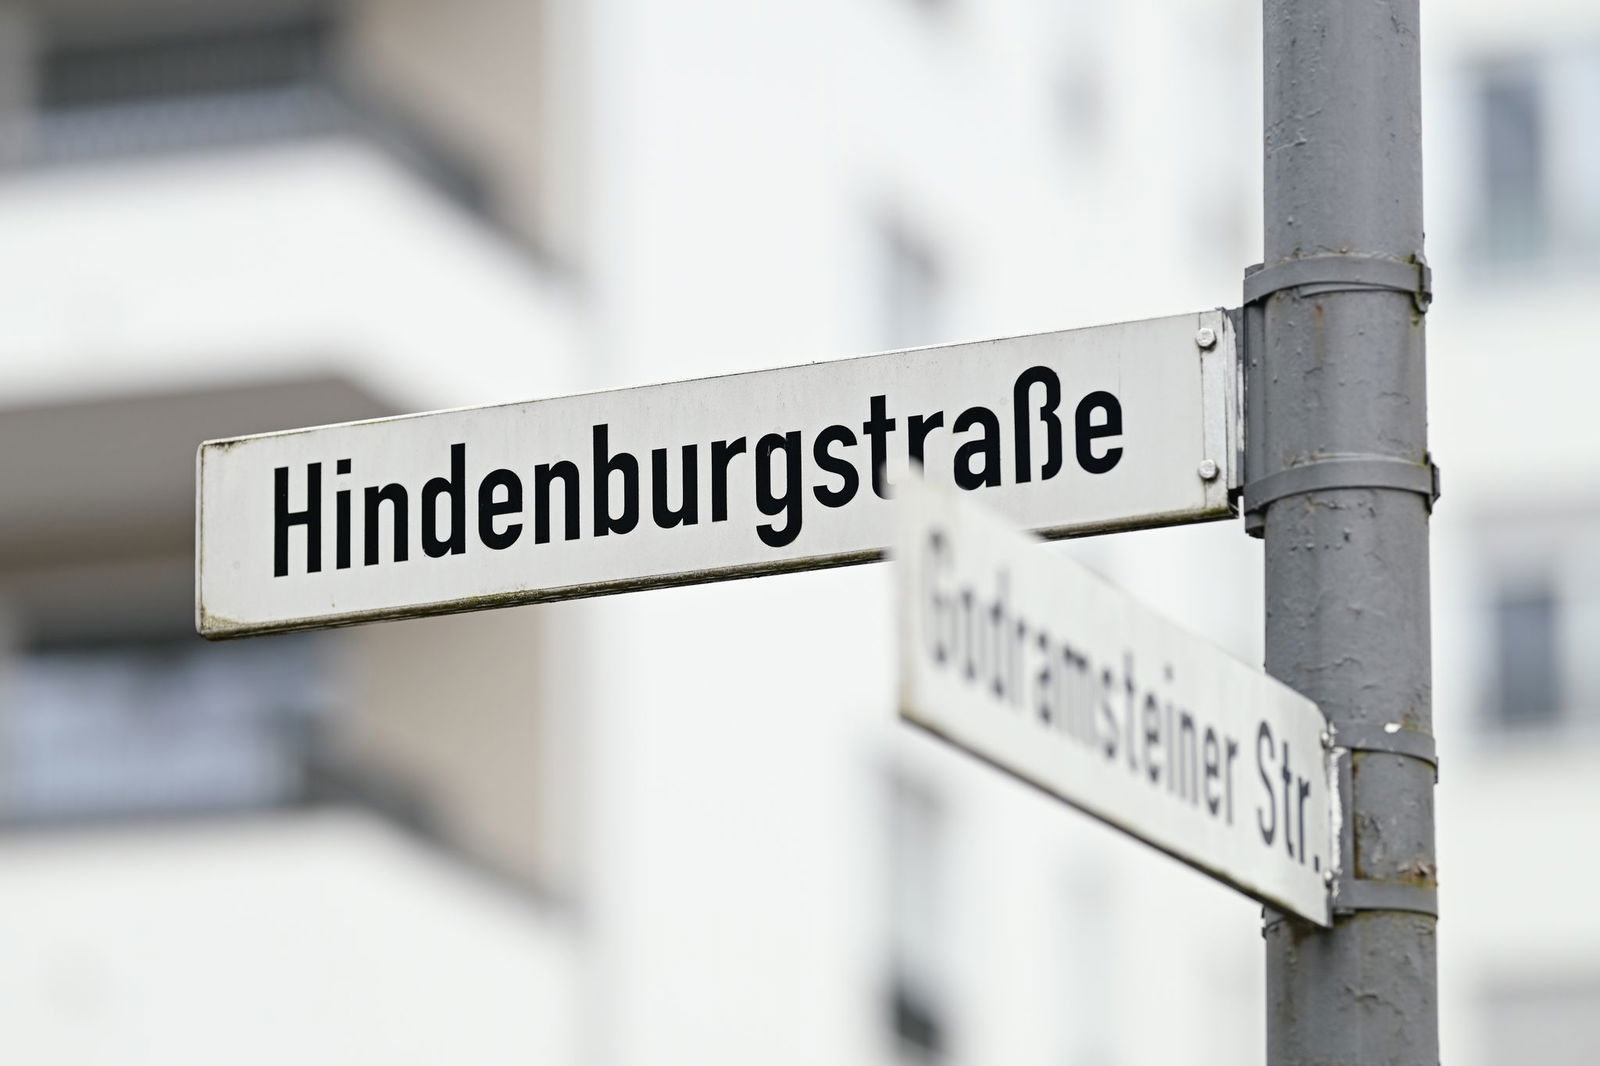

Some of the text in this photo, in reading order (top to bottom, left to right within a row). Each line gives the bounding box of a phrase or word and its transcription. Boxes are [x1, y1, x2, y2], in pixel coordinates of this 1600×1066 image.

[274, 365, 1124, 578] Hindenburgstraße
[921, 526, 1320, 873] Godramsteiner Str.
